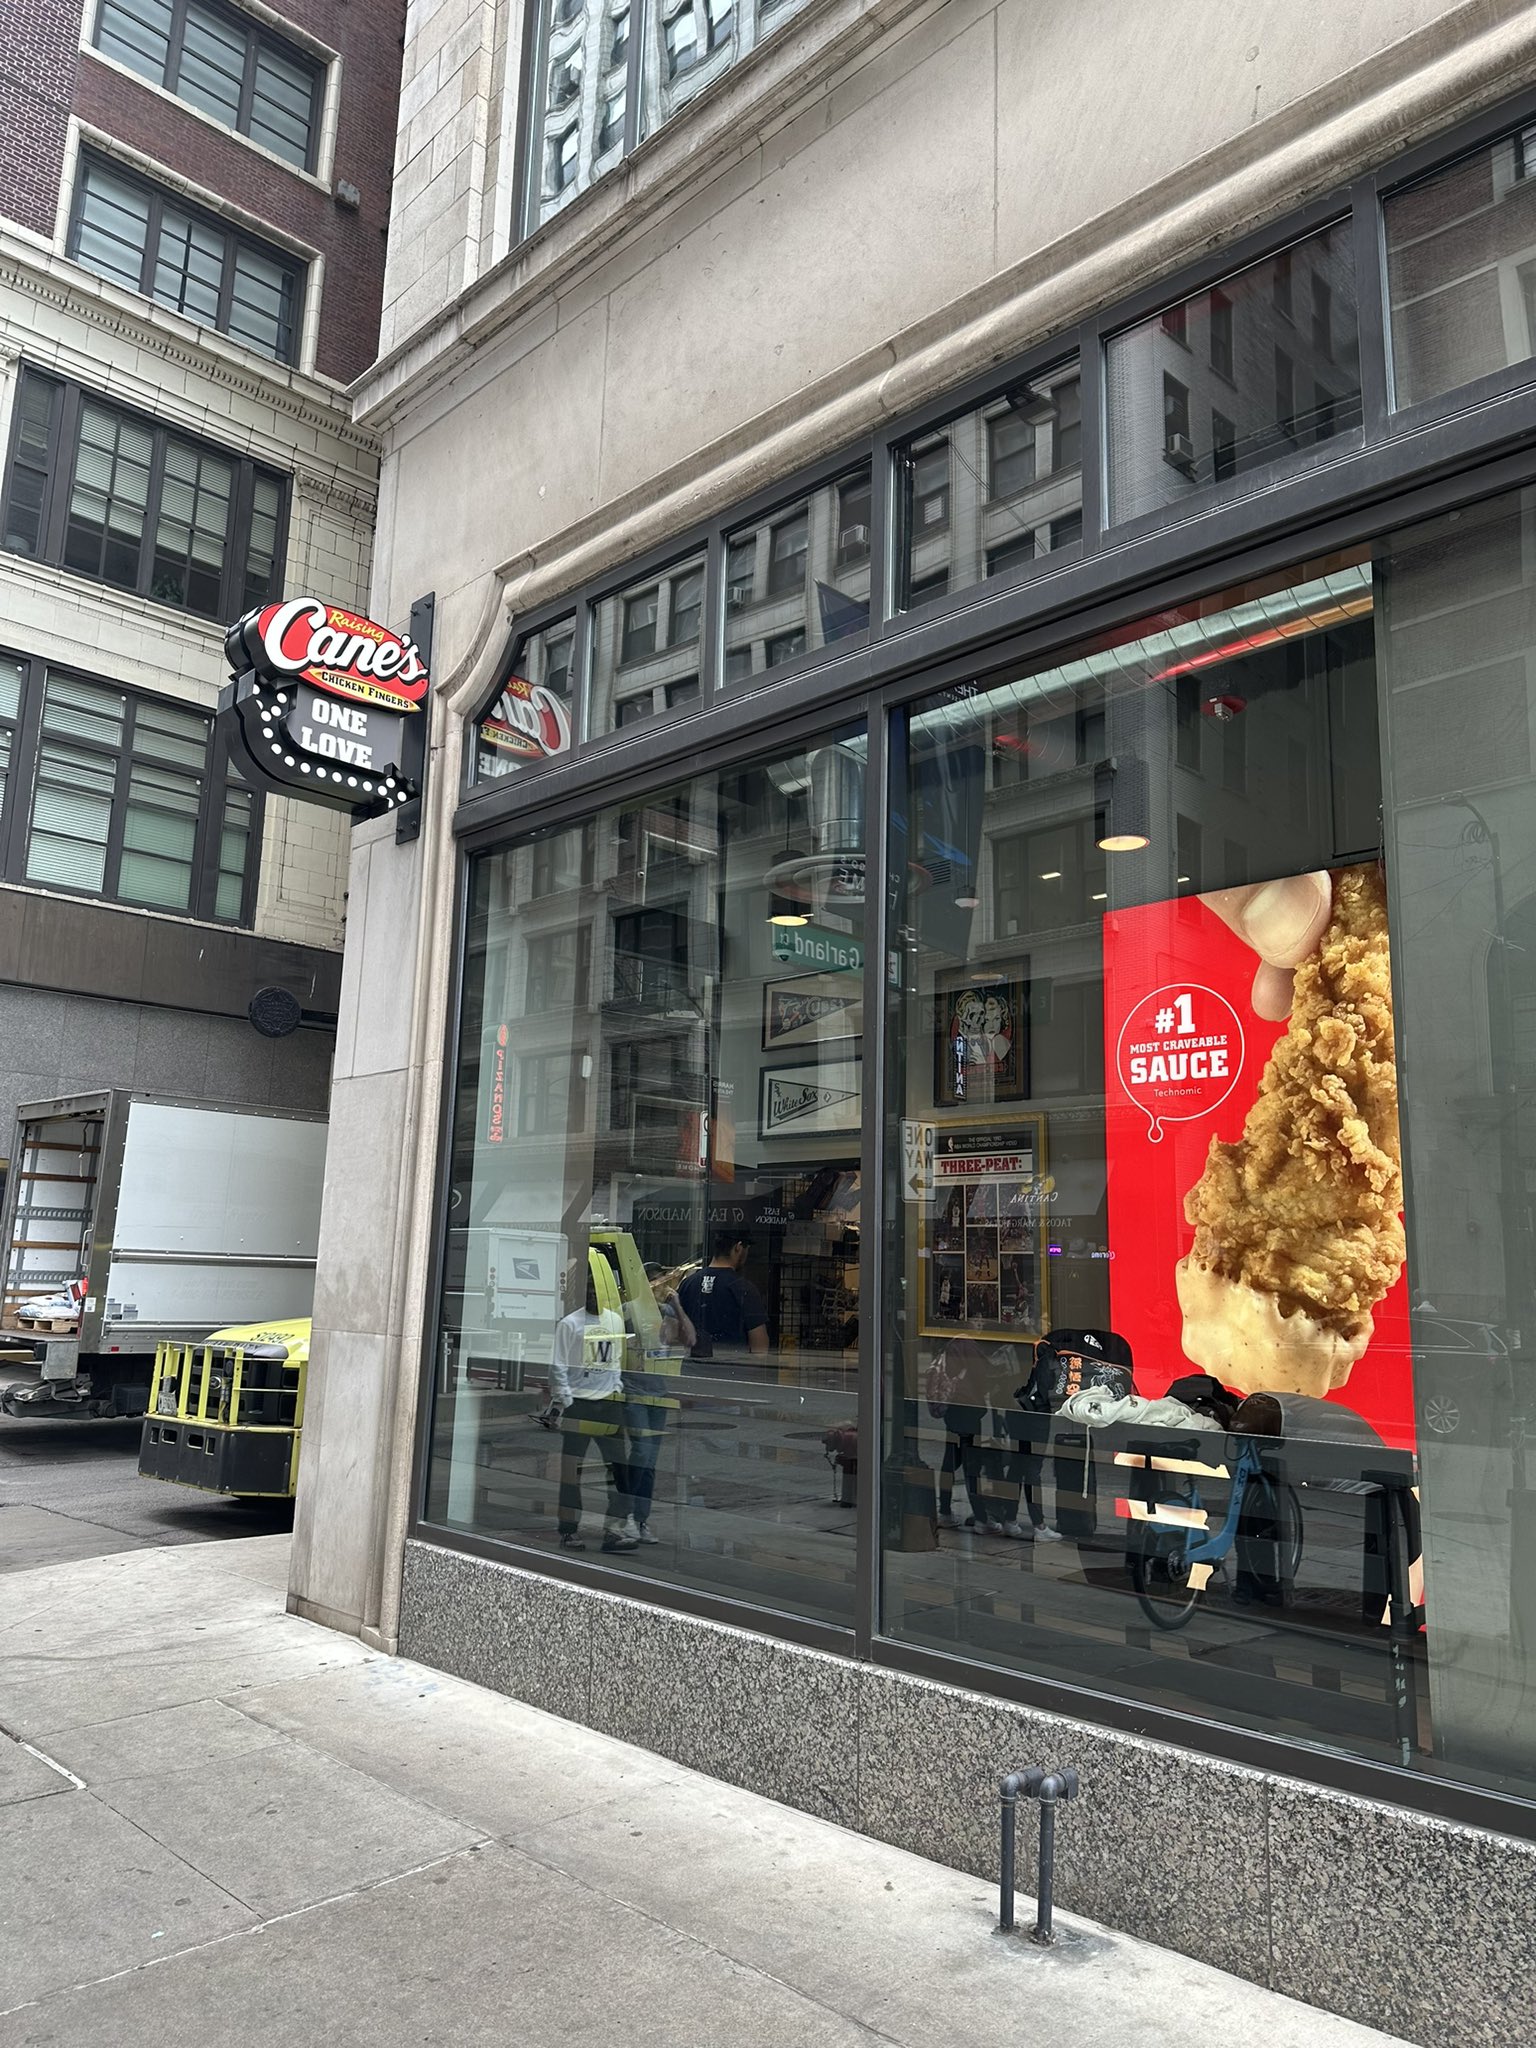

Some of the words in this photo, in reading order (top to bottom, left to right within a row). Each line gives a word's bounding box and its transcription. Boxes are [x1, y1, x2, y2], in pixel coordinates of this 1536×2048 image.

[265, 597, 427, 682] Cane's
[329, 609, 385, 643] Raising
[321, 670, 366, 696] CHICKEN
[367, 686, 410, 709] FINGERS
[311, 698, 369, 738] ONE
[300, 727, 373, 770] LOVE
[1154, 993, 1196, 1034] #1
[1129, 1042, 1161, 1054] MOST
[1163, 1035, 1228, 1051] CRAVEABLE
[1130, 1050, 1229, 1084] SAUCE
[773, 1097, 799, 1117] White
[799, 1087, 818, 1104] Sox
[1154, 1086, 1202, 1097] Technomic
[941, 1156, 1022, 1173] THREE-PEAT:
